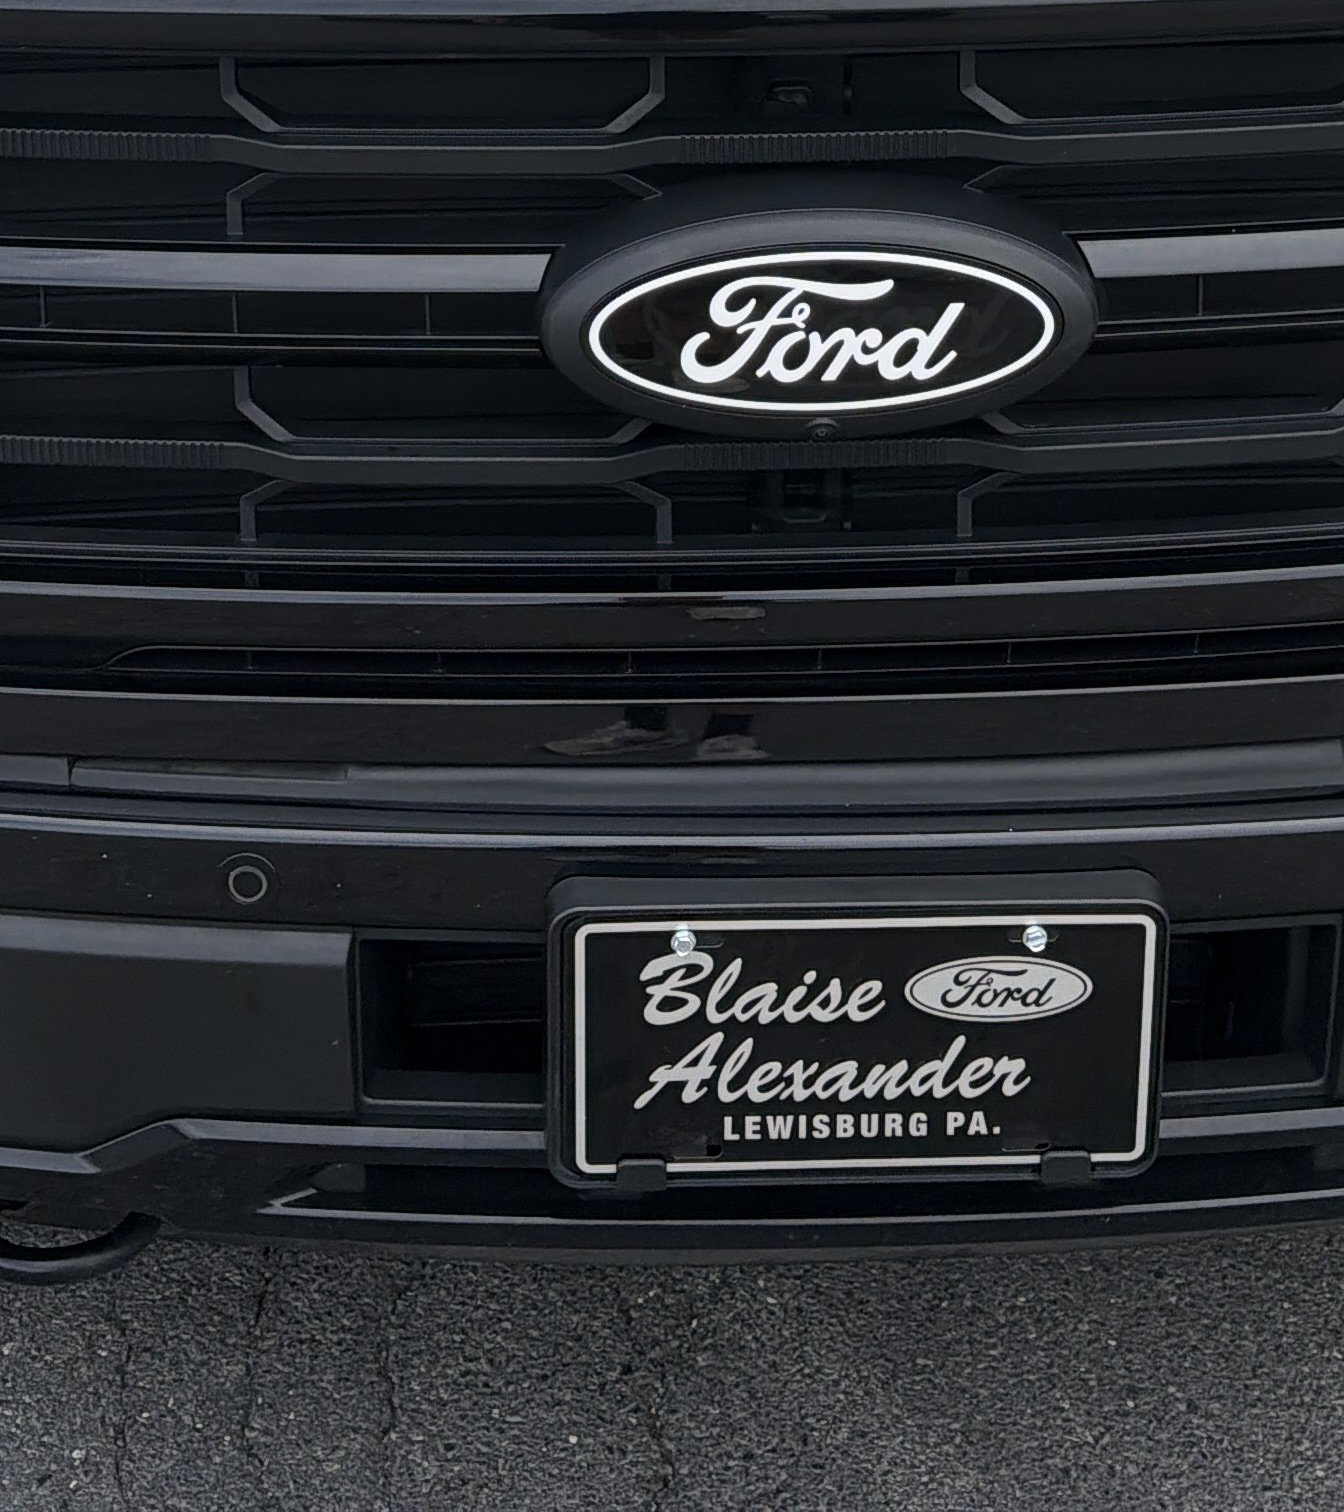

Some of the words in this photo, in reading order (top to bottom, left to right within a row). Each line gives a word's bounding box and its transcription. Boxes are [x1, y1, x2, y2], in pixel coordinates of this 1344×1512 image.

[679, 275, 965, 384] Ford
[638, 950, 886, 1026] Blaise
[940, 967, 1057, 1009] Ford
[633, 1031, 1032, 1110] Alexander
[722, 1112, 929, 1141] LEWISBURG
[945, 1111, 1002, 1137] PA.
